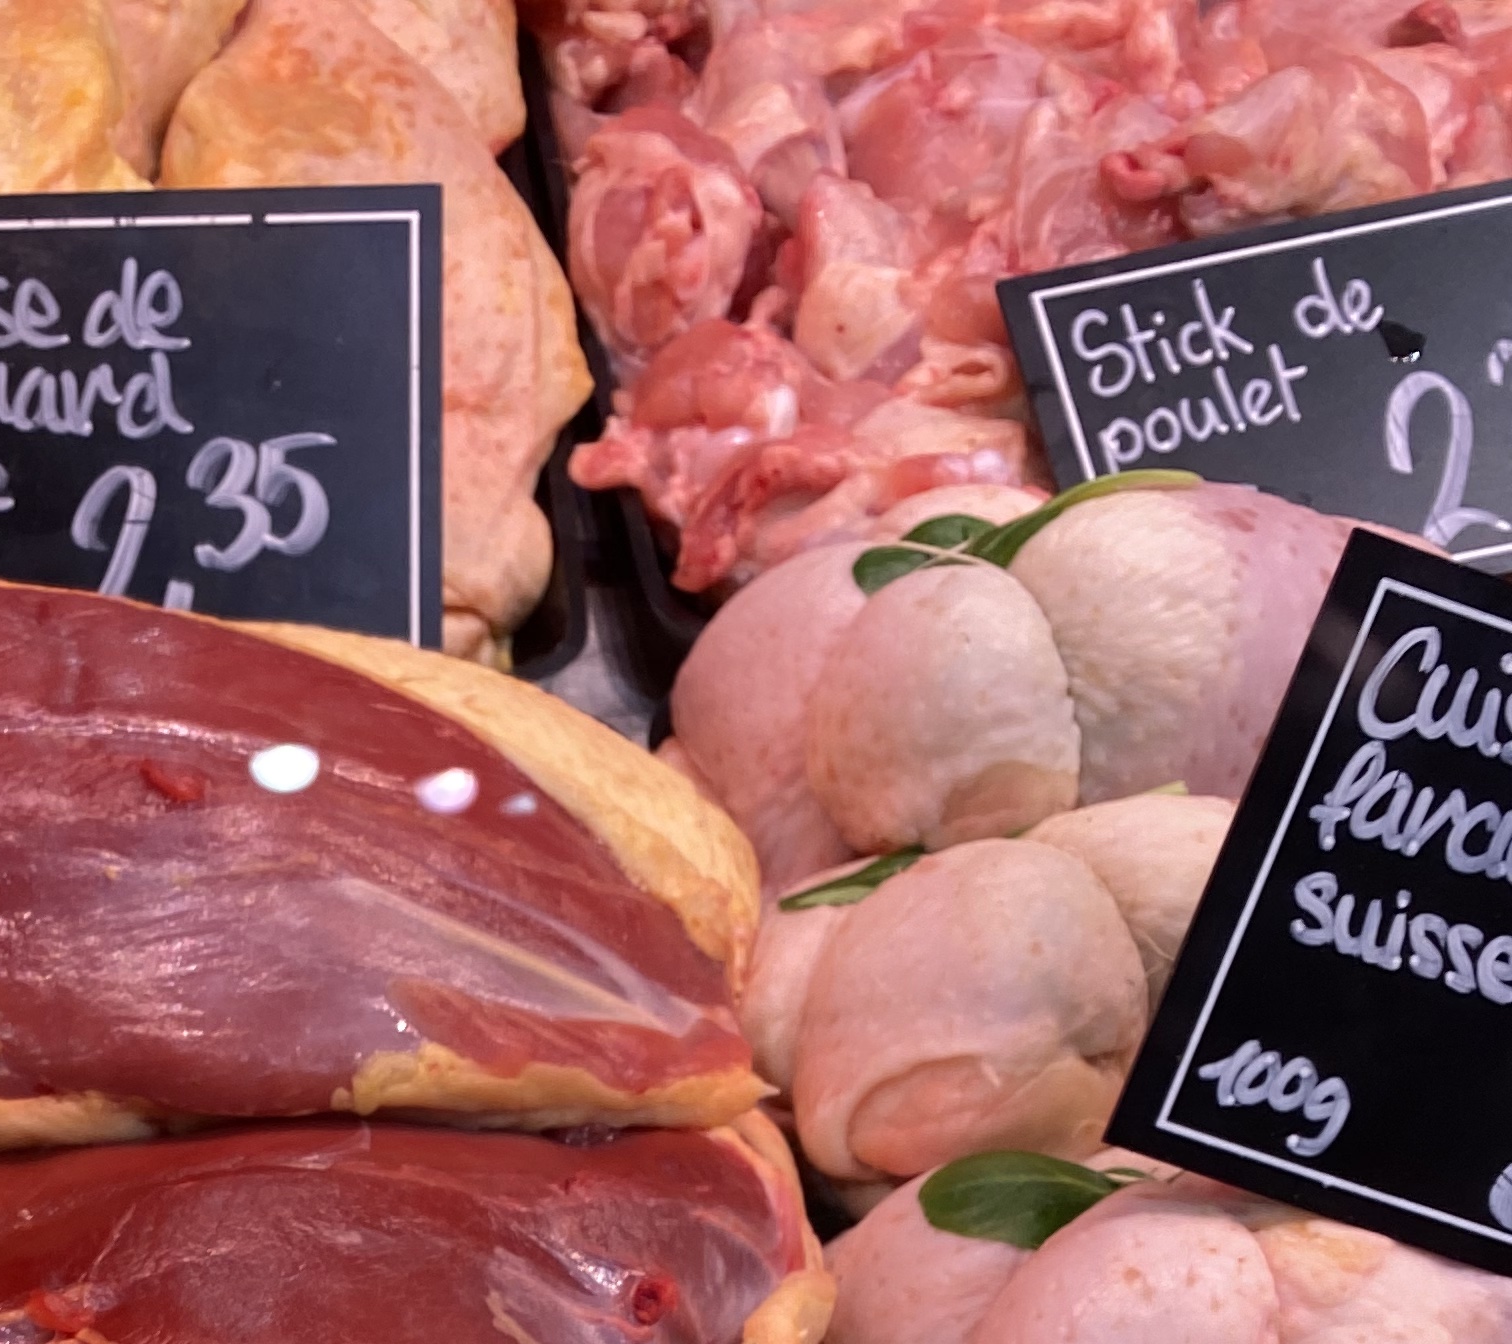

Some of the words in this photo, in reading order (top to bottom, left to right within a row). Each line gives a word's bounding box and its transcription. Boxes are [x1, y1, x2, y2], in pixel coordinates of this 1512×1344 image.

[84, 257, 191, 346] de
[1071, 278, 1254, 397] Stick
[1293, 256, 1384, 338] de
[1097, 343, 1308, 475] poulet
[1358, 626, 1512, 765] Cui
[1198, 1039, 1351, 1158] 100g
